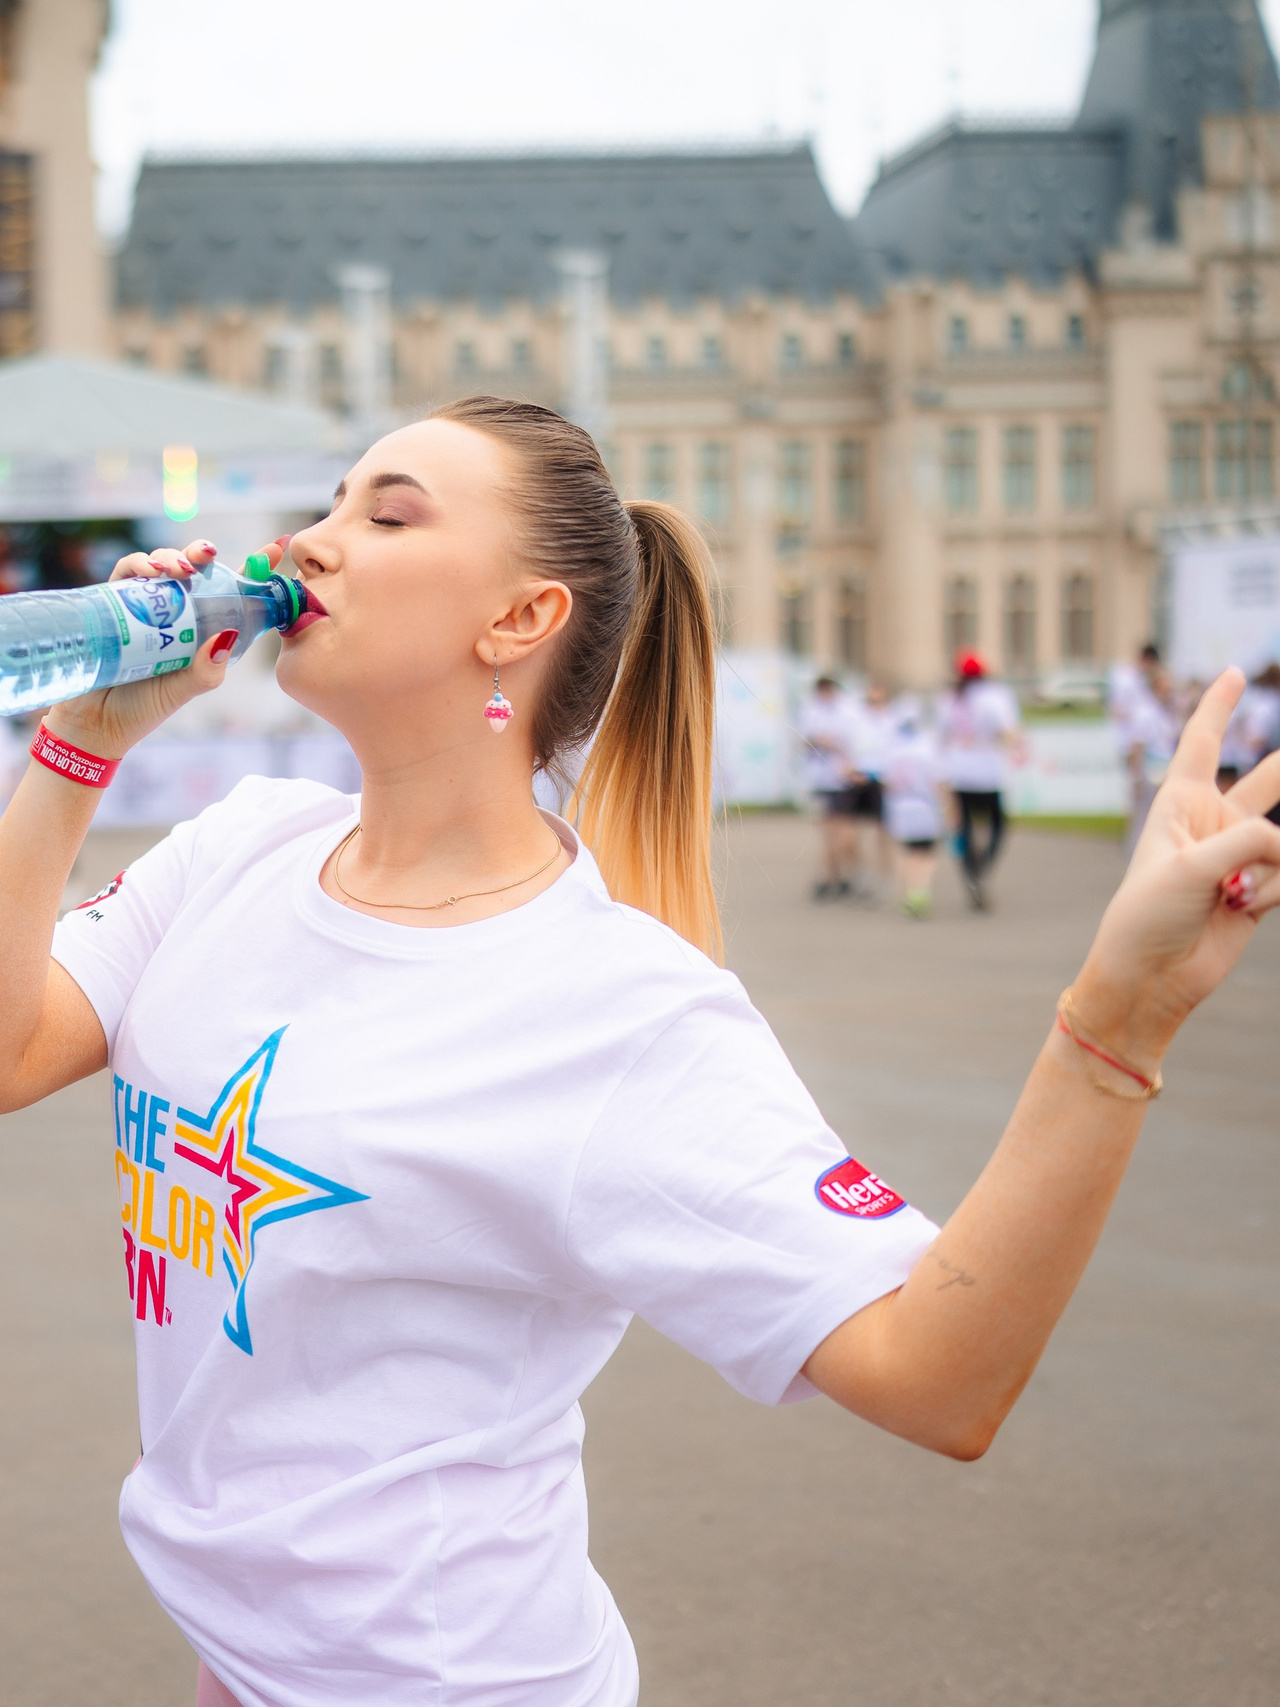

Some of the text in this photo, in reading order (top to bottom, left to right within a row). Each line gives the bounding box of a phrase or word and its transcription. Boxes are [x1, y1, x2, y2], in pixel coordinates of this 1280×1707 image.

[55, 743, 101, 768] amazing tour
[55, 754, 87, 777] COLOR
[84, 767, 102, 782] THE
[86, 909, 104, 922] FM
[113, 1072, 170, 1173] THE
[854, 1192, 894, 1215] SPORTS
[122, 1227, 167, 1327] RN
